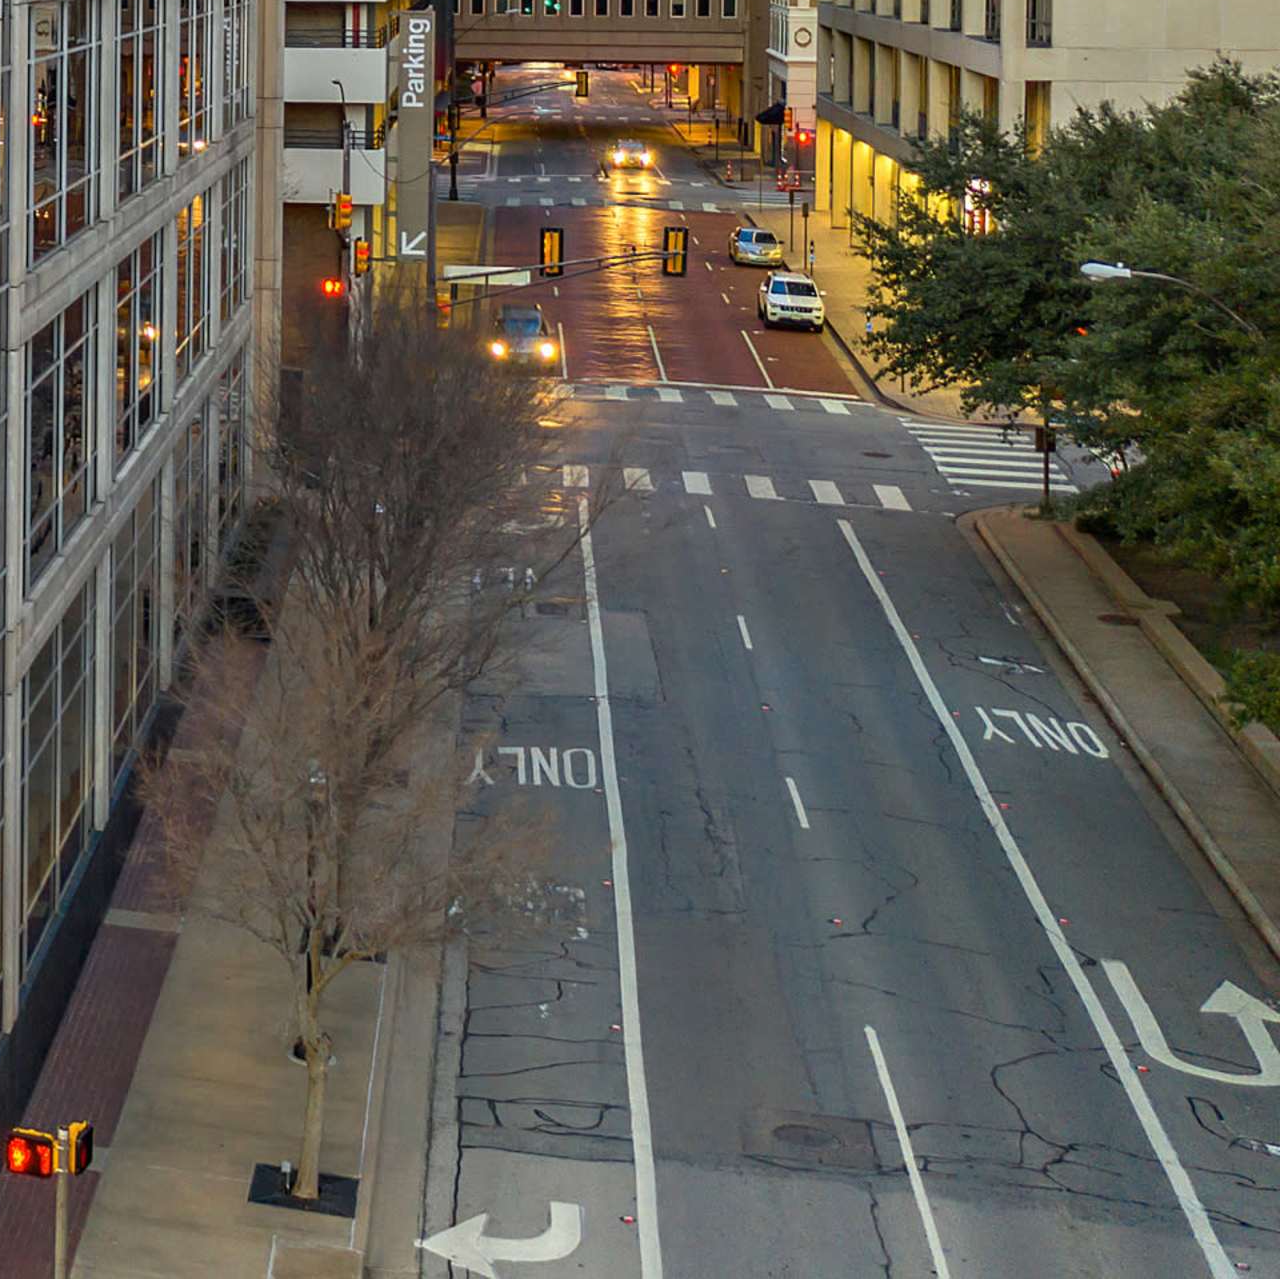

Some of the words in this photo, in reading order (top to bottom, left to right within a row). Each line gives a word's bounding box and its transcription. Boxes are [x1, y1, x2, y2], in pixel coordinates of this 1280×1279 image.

[401, 18, 431, 109] Parking
[974, 706, 1110, 759] ONLY
[464, 746, 598, 789] ONLY
